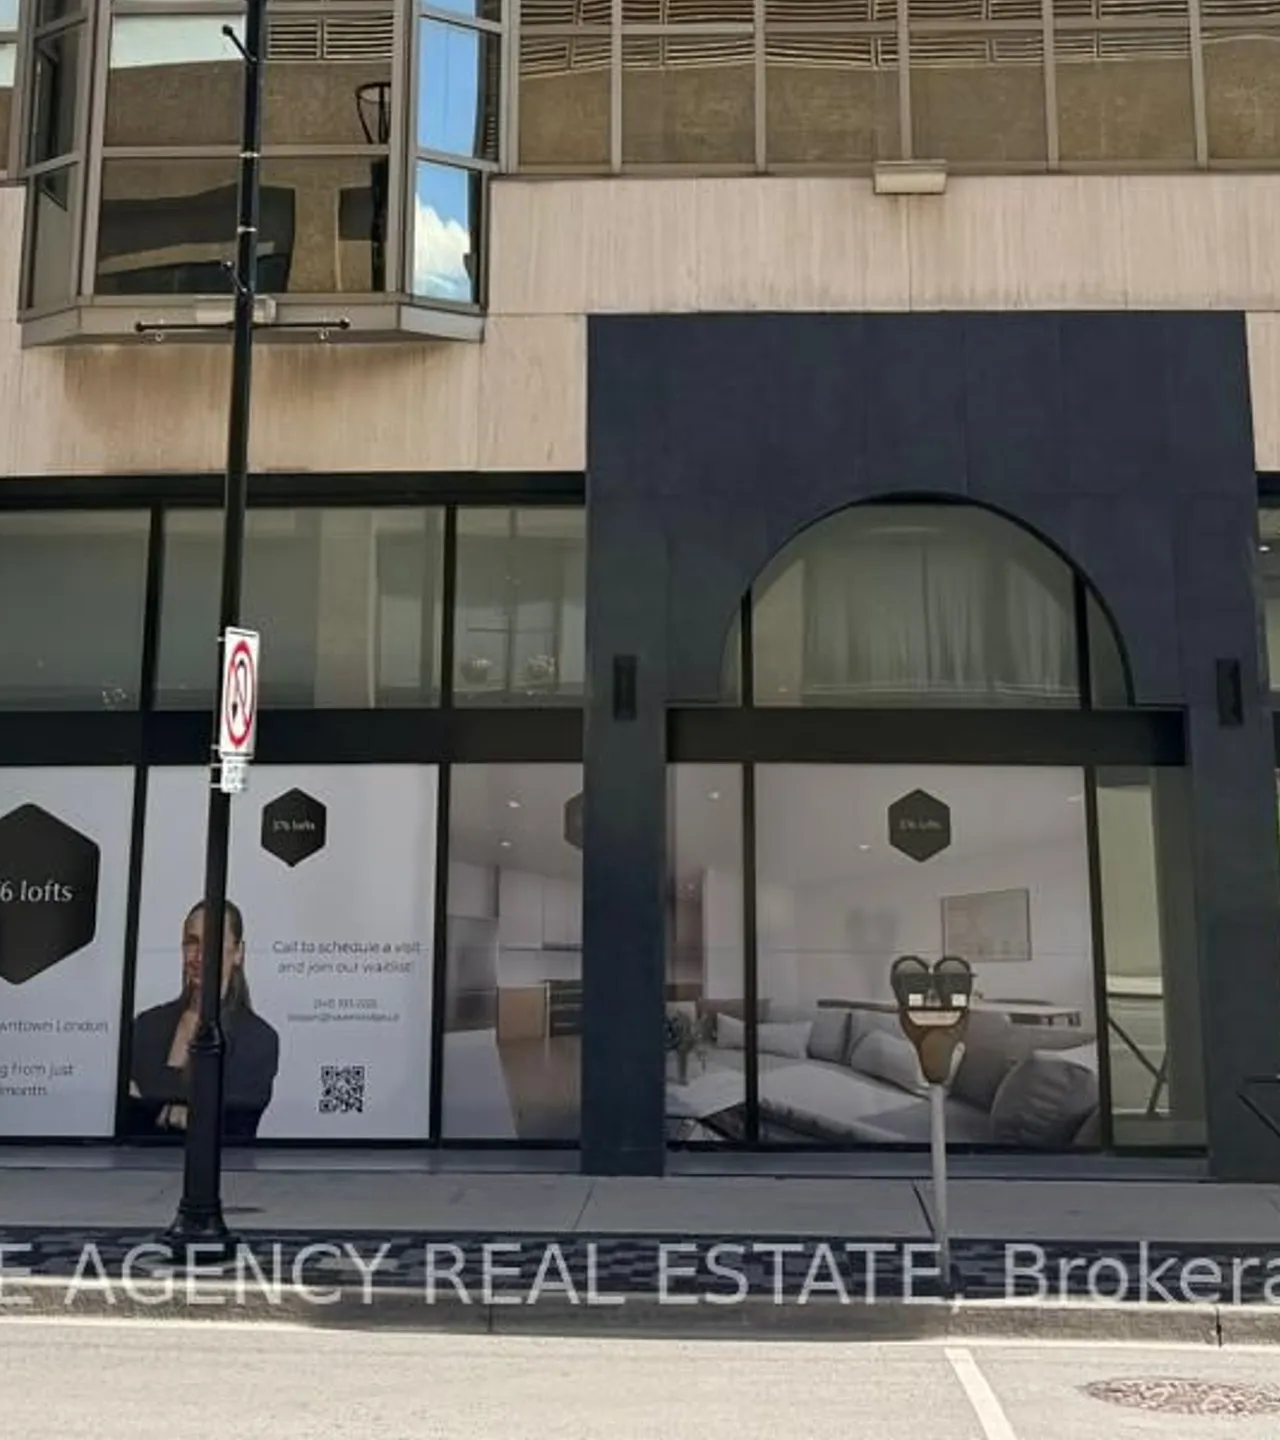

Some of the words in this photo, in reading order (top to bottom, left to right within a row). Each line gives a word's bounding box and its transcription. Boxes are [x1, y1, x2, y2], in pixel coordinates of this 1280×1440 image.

[20, 879, 73, 902] lofts
[300, 942, 315, 954] to
[319, 941, 380, 954] schedule
[382, 944, 392, 954] a
[11, 1063, 46, 1077] from
